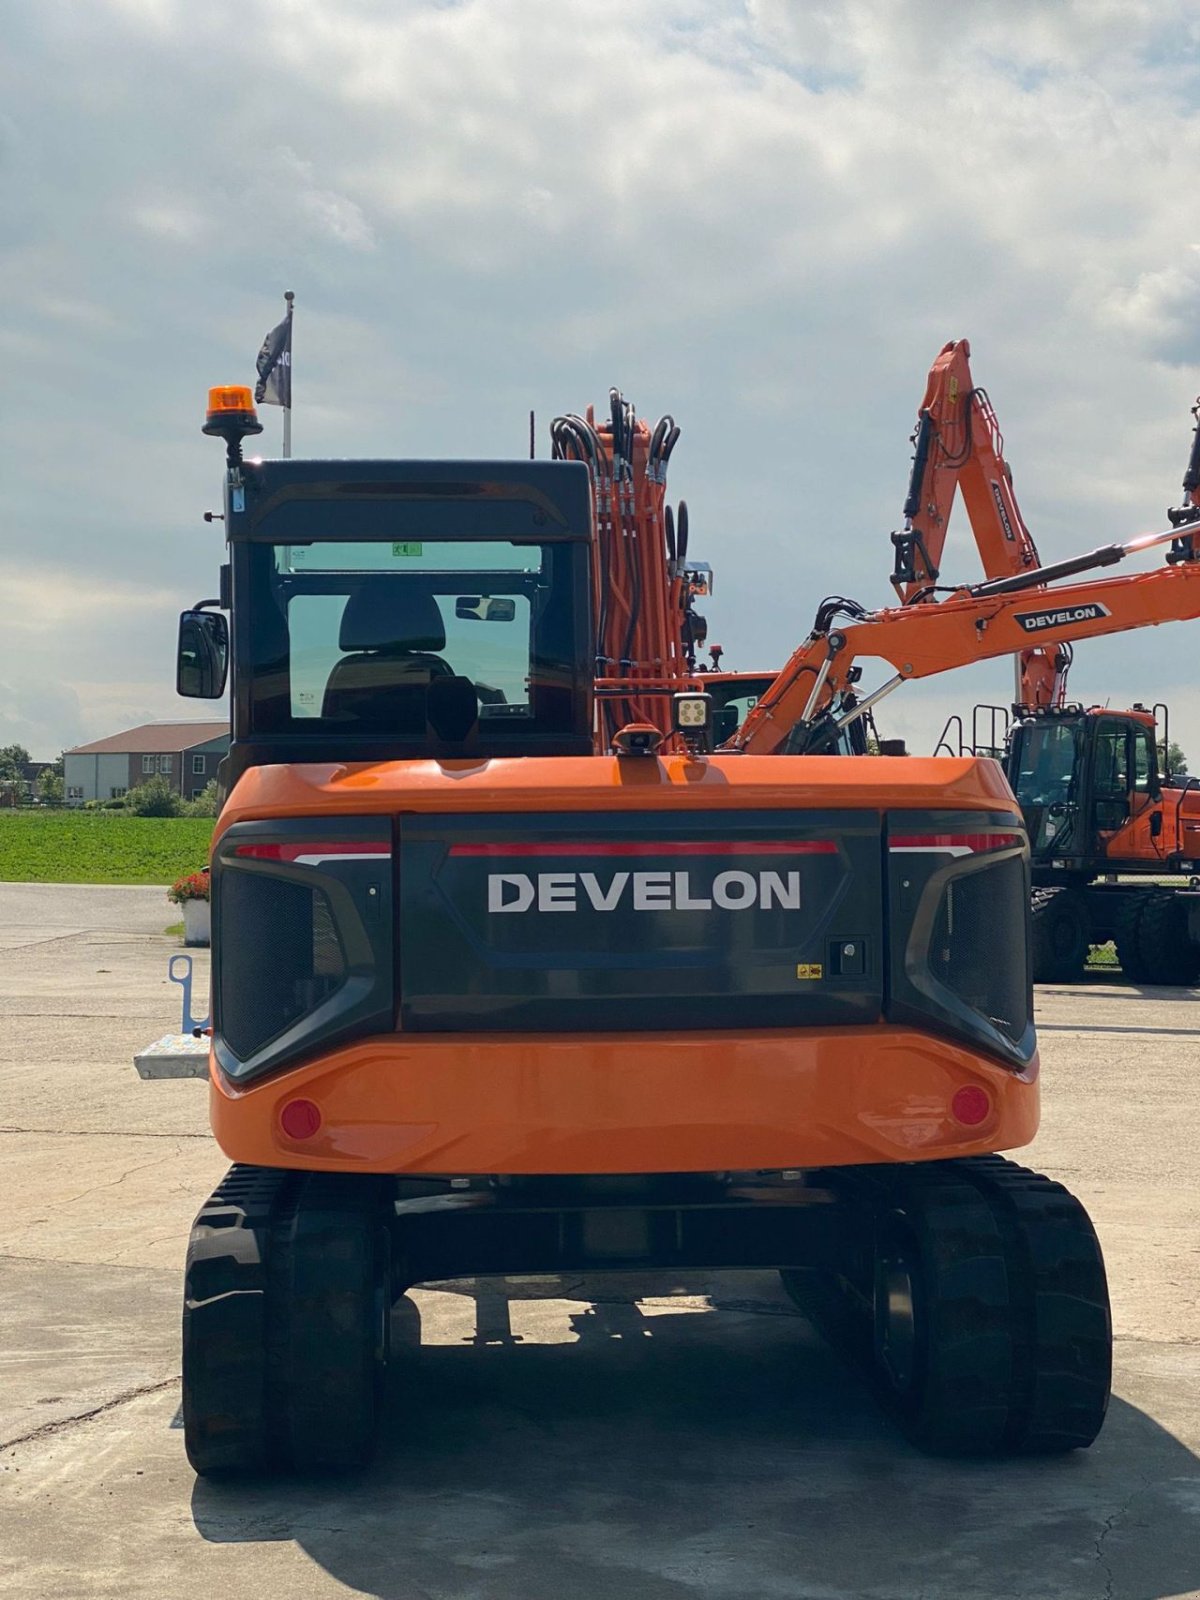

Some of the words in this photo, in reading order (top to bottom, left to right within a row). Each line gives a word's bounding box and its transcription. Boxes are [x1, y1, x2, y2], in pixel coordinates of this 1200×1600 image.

[994, 488, 1012, 538] DEVELON
[1025, 607, 1096, 629] DEVELON
[488, 870, 800, 913] DEVELON
